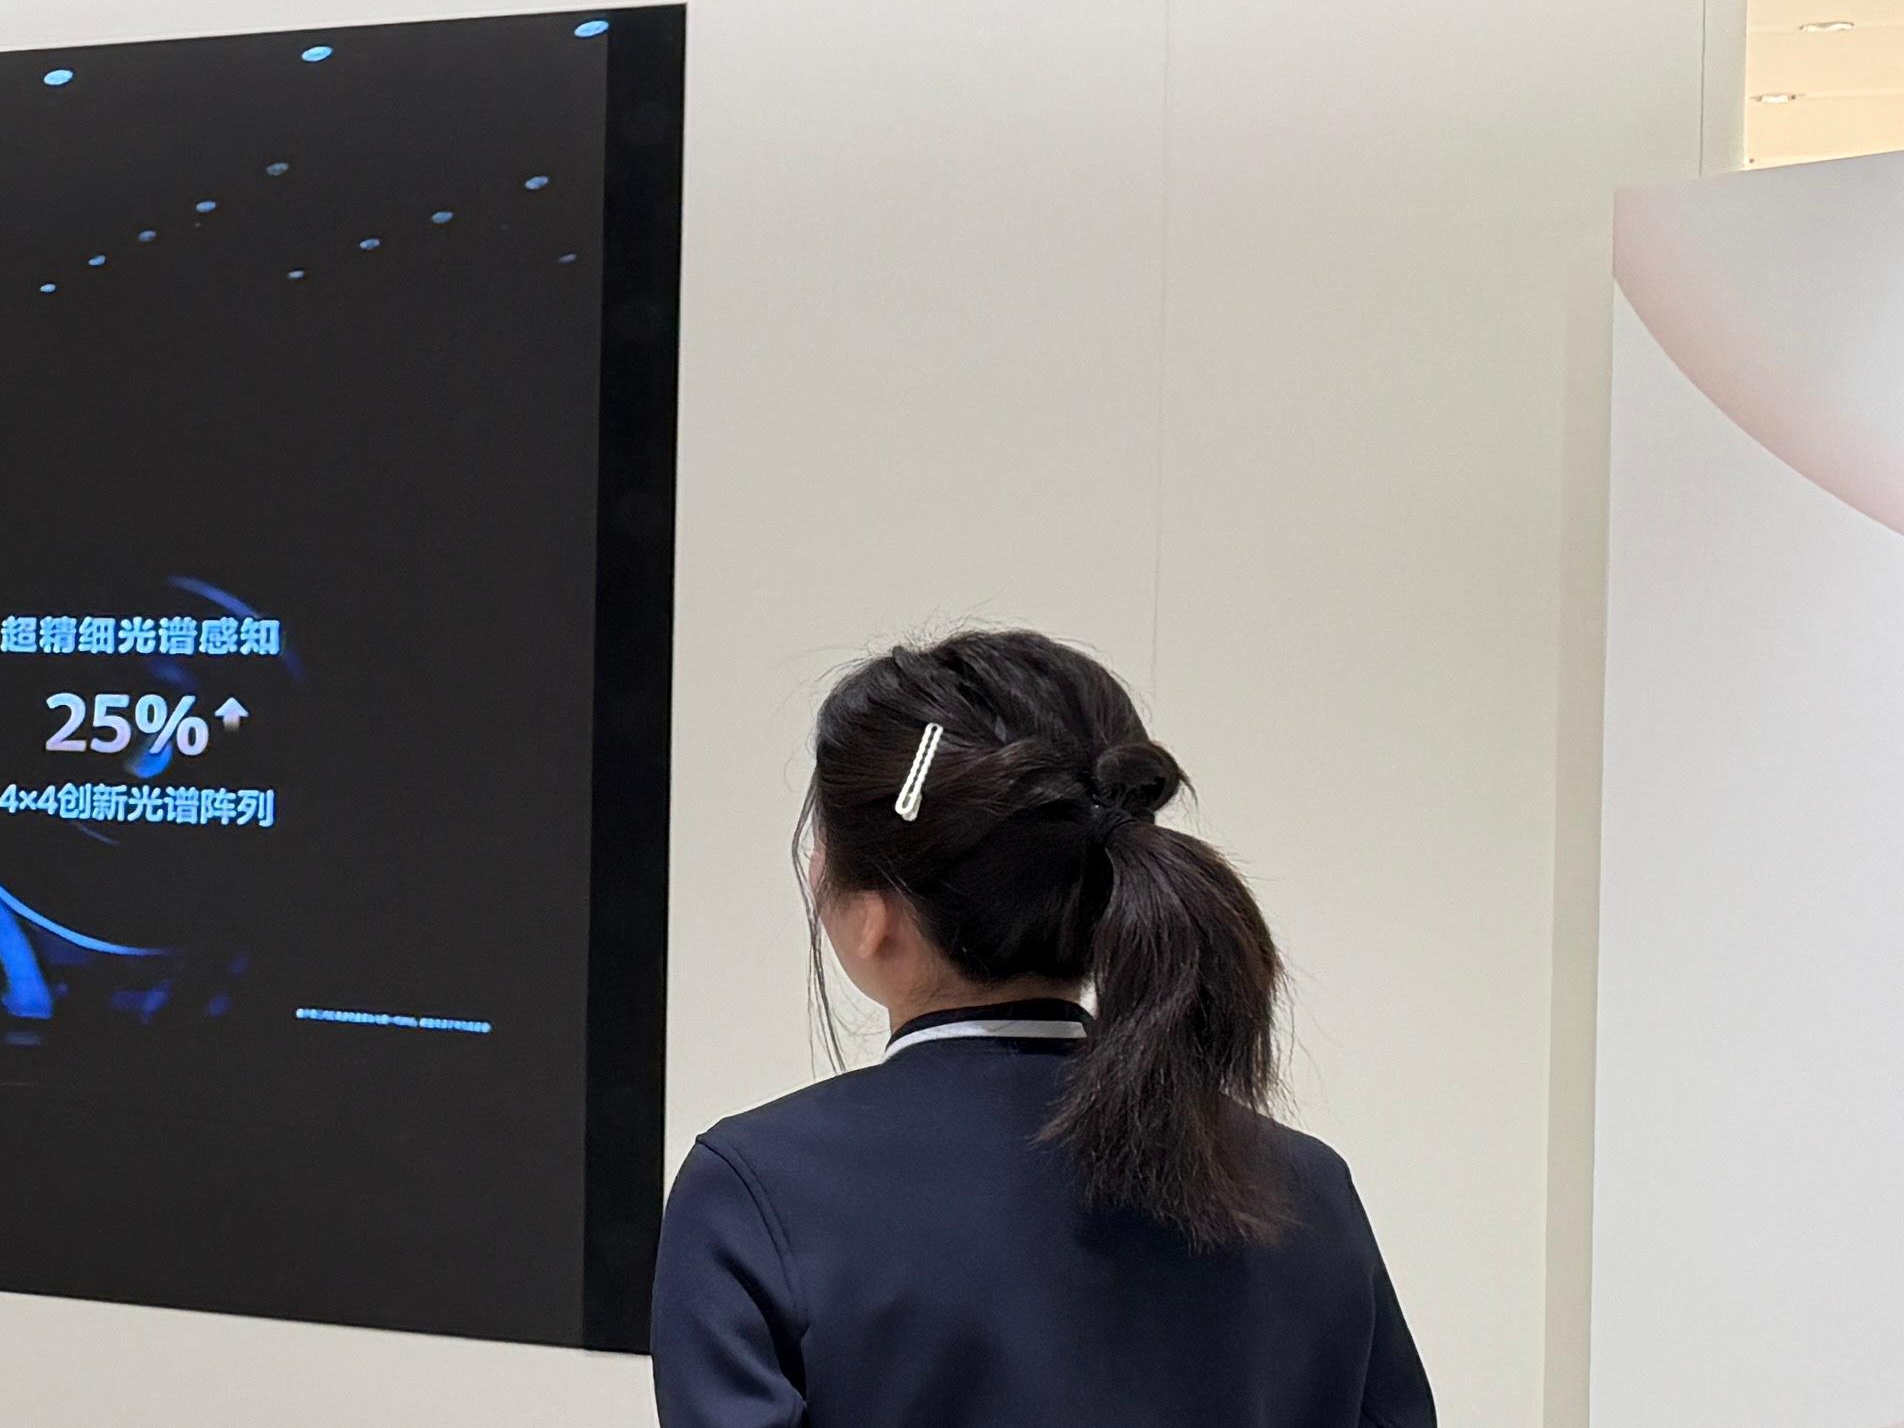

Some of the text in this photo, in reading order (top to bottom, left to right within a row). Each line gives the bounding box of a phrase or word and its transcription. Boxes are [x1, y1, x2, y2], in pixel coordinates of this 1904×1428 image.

[0, 615, 281, 656] 超精细光谱感知
[45, 692, 210, 756] 25%
